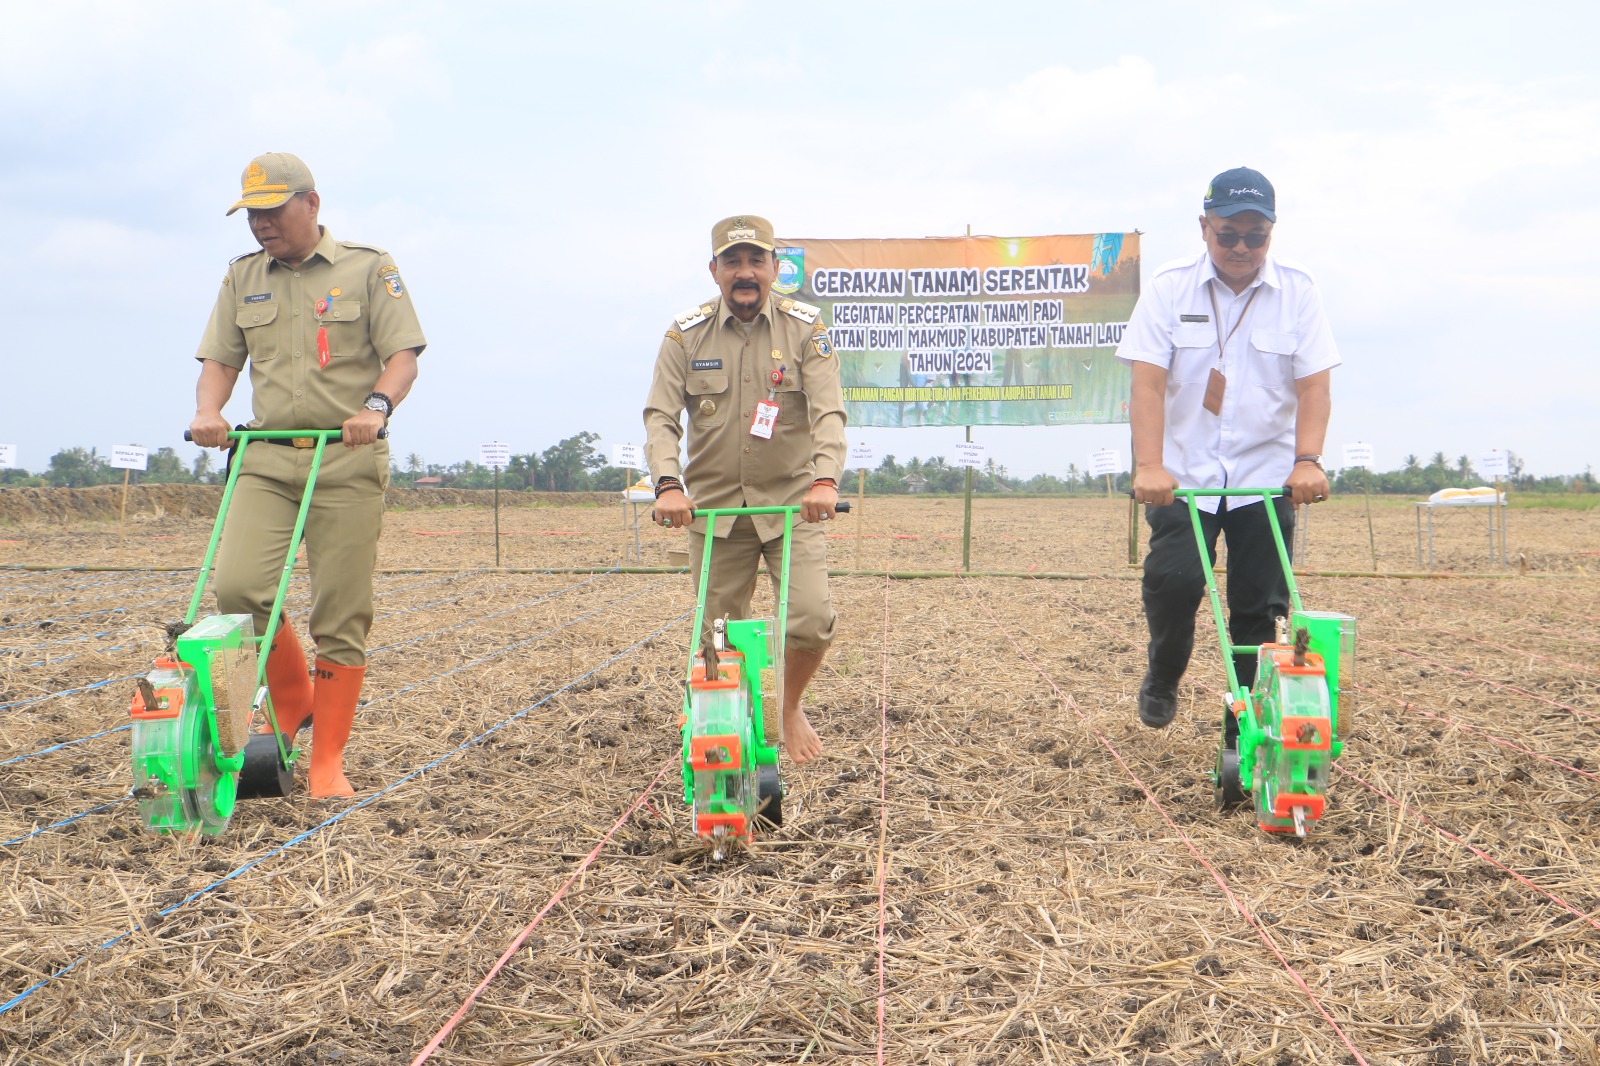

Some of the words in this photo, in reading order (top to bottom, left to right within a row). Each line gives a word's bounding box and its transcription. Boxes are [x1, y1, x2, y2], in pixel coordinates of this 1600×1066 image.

[814, 270, 903, 294] GERAKAN
[910, 269, 978, 293] TANAM
[986, 266, 1087, 292] SERENTAK
[834, 304, 894, 325] KEGIATAN
[899, 304, 979, 324] PERCEPATAN
[983, 302, 1029, 323] TANAM
[1033, 301, 1062, 321] PADI
[869, 329, 903, 348] BUMI
[908, 328, 967, 348] MAKMUR
[971, 326, 1046, 347] KABUPATEN
[1050, 325, 1092, 346] TANAH
[909, 352, 952, 372] TAHUN
[957, 352, 991, 371] 2024
[849, 387, 879, 401] TANAMAN
[880, 387, 904, 401] PANGAN
[948, 387, 961, 401] DAN
[962, 386, 1000, 401] PERKEBUNAN
[1001, 385, 1036, 400] KABUPATEN
[1037, 384, 1057, 400] TANAH
[1058, 384, 1073, 399] LAUT
